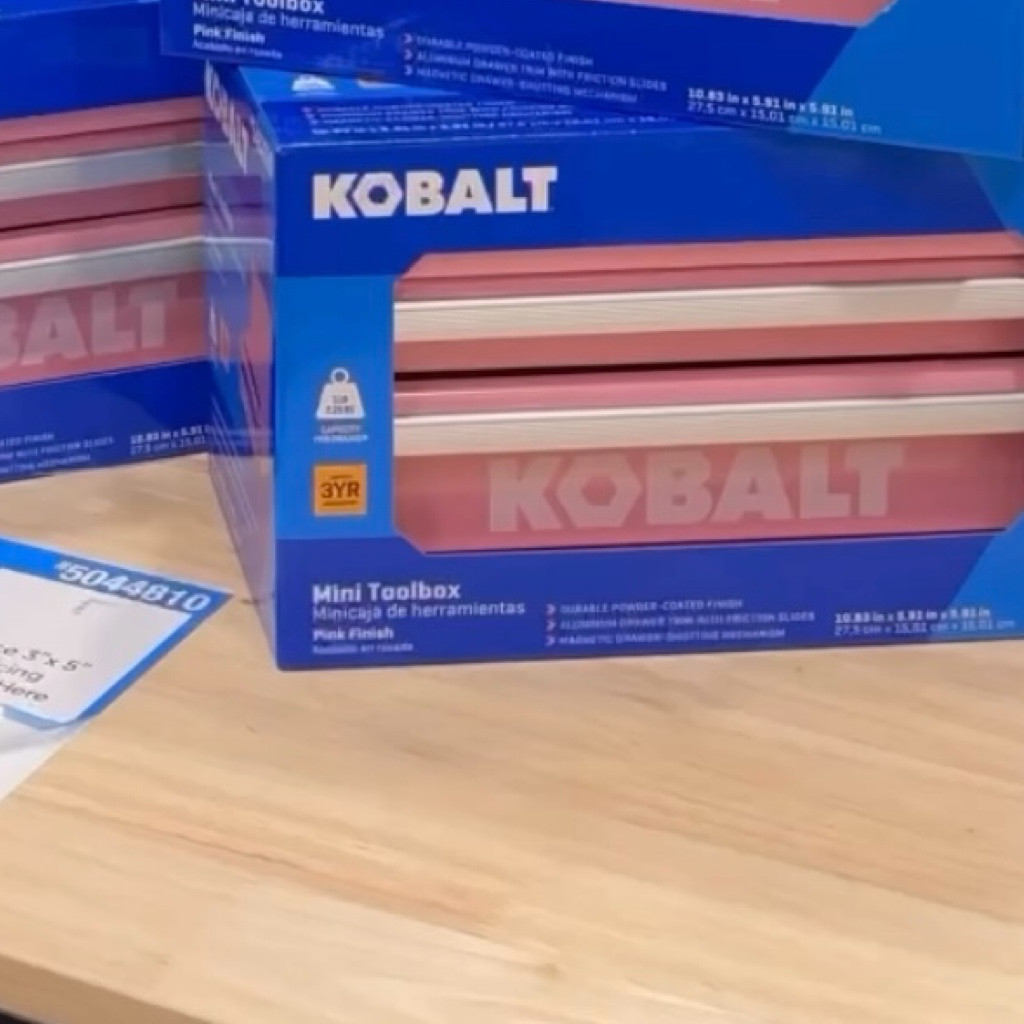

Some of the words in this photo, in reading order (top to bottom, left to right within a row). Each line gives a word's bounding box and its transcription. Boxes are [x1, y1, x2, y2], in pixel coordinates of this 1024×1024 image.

[192, 2, 255, 25] Minicaja
[258, 8, 277, 25] de
[280, 11, 386, 40] herramientas
[193, 24, 225, 39] Pink
[226, 27, 266, 45] Finish
[312, 164, 559, 220] KOBALT
[320, 481, 360, 499] 3YR
[488, 443, 906, 532] KOBALT
[312, 582, 362, 604] Mini
[366, 580, 462, 602] Toolbox
[312, 605, 383, 624] Minicaja
[386, 603, 408, 619] de
[410, 600, 526, 619] herramientas
[312, 626, 346, 641] Pink
[348, 626, 395, 640] Finish
